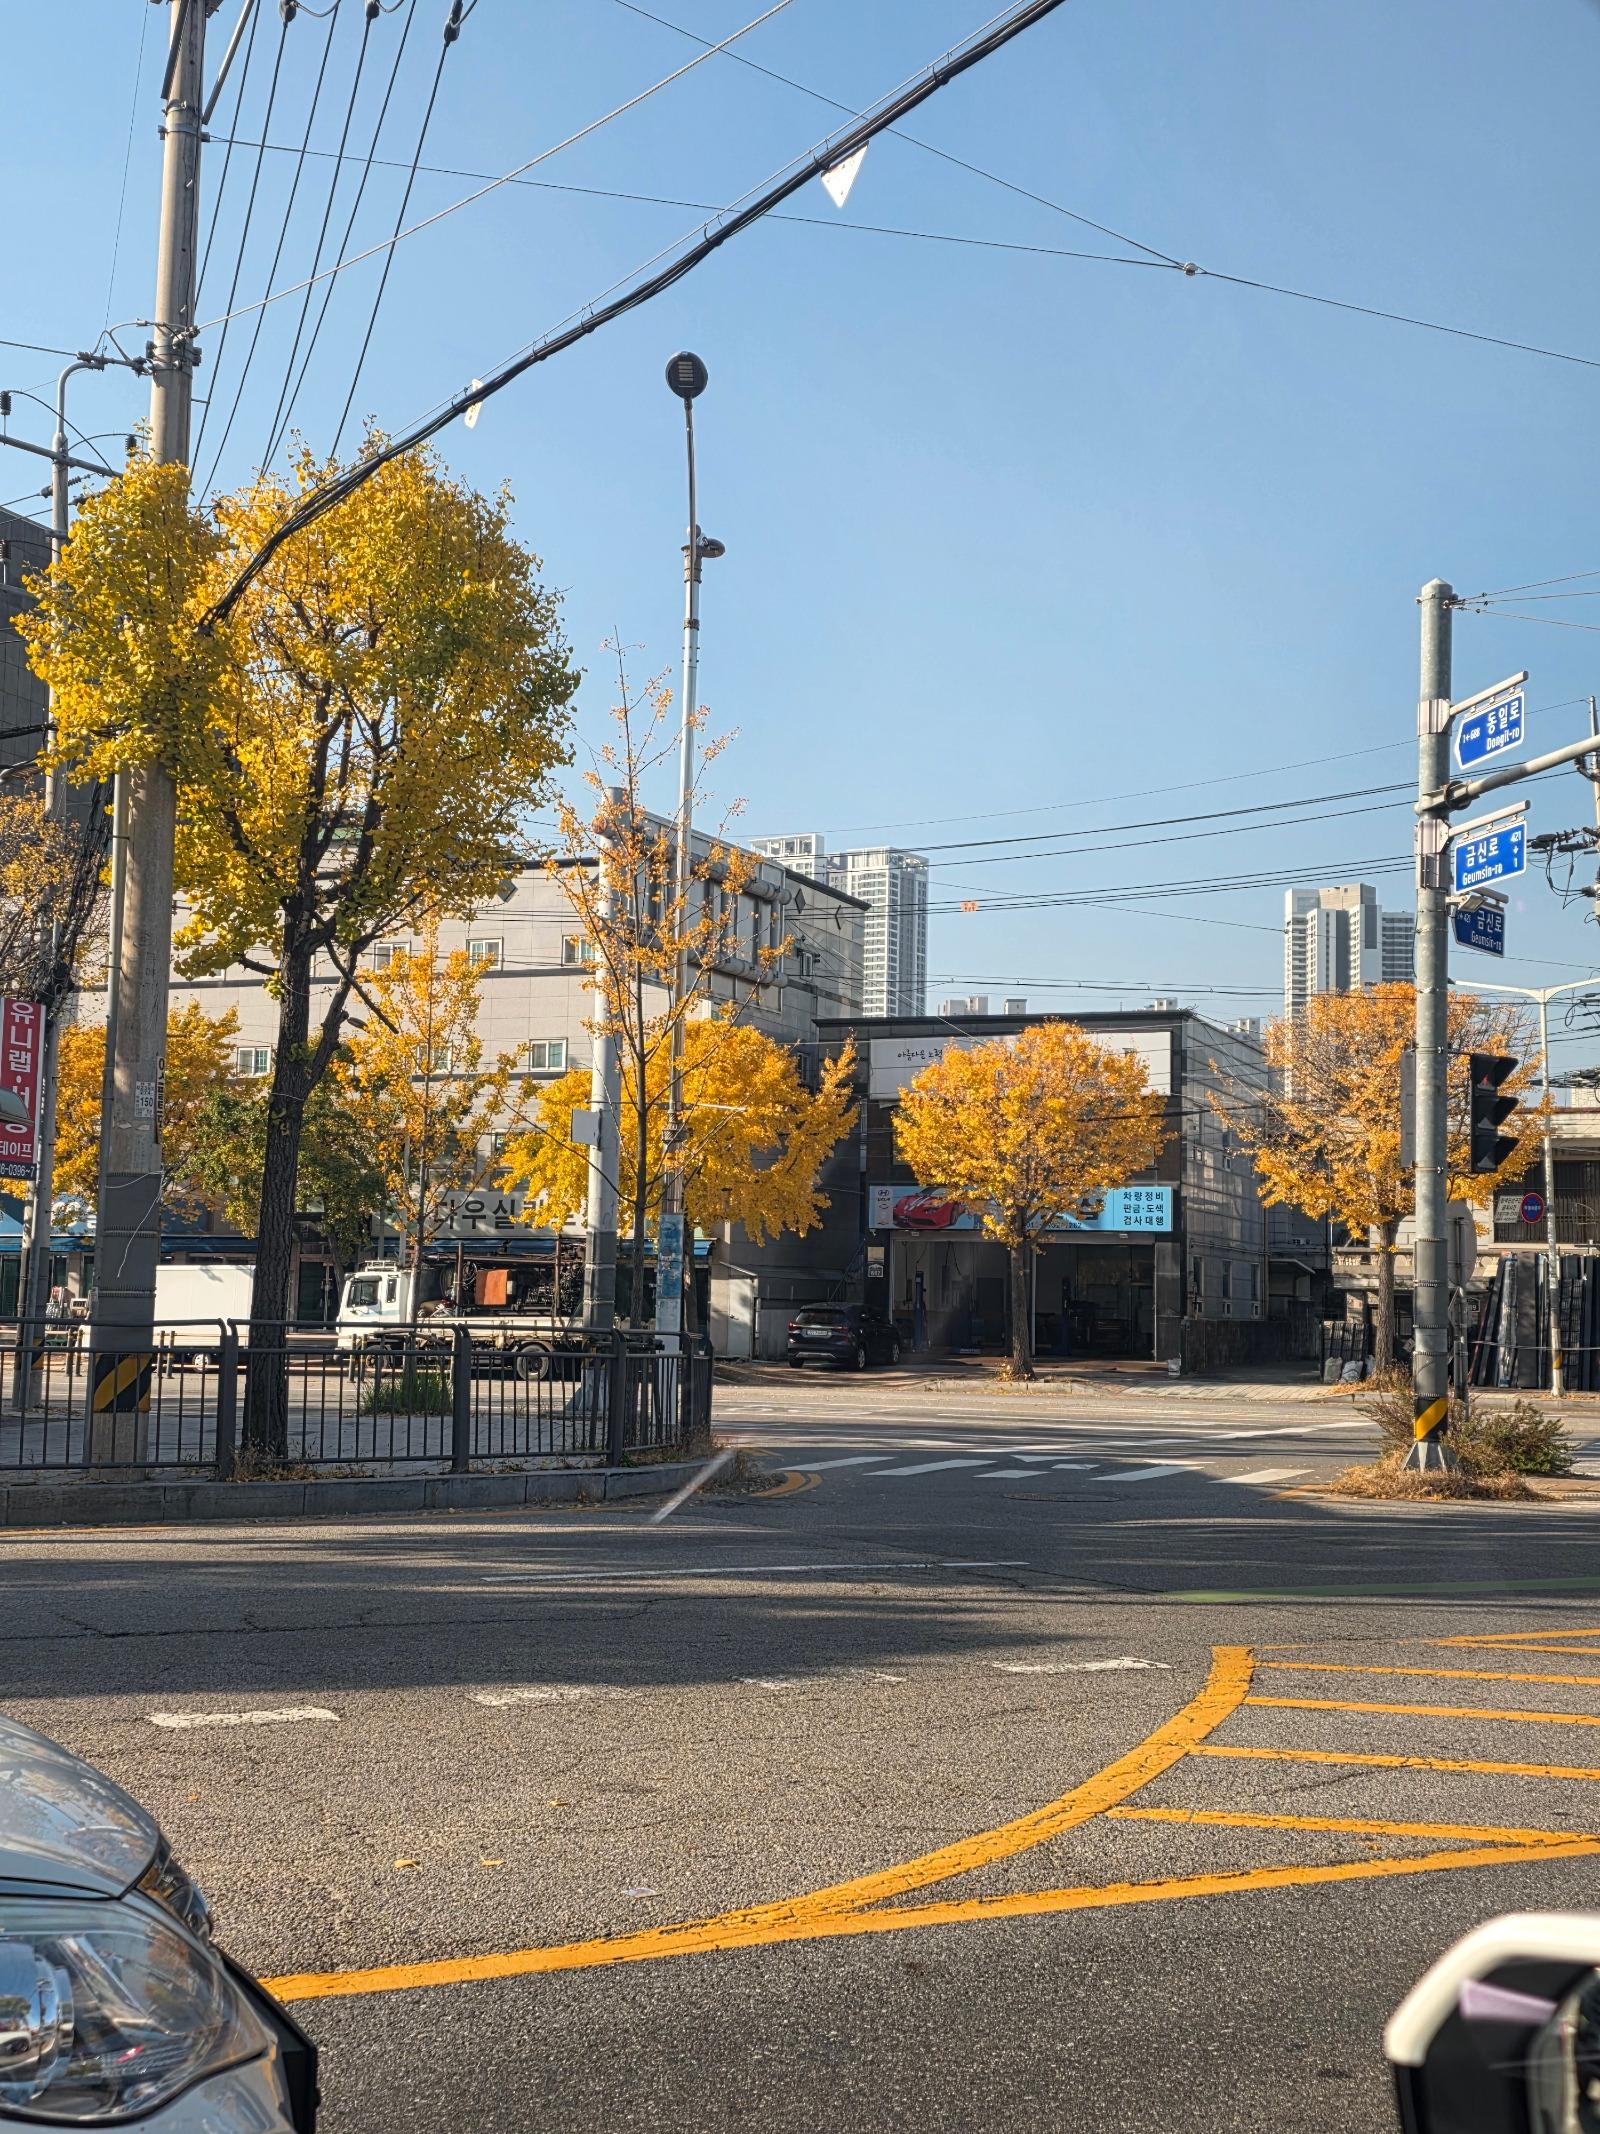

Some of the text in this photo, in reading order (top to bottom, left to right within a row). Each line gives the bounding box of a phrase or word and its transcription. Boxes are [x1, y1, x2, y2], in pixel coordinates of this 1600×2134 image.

[1487, 700, 1520, 735] 동일로
[1486, 727, 1520, 751] Dongil-ro
[1465, 836, 1499, 867] 금신로
[1462, 863, 1503, 885] Geumsin-ro
[1477, 909, 1502, 933] 금신로
[1471, 930, 1502, 951] Geumsin-ro
[897, 1049, 926, 1061] 아름다운
[140, 1097, 154, 1107] 150
[1123, 1191, 1164, 1202] 차량정비
[1123, 1203, 1164, 1214] 판금·도색
[1123, 1215, 1164, 1226] 검사대행
